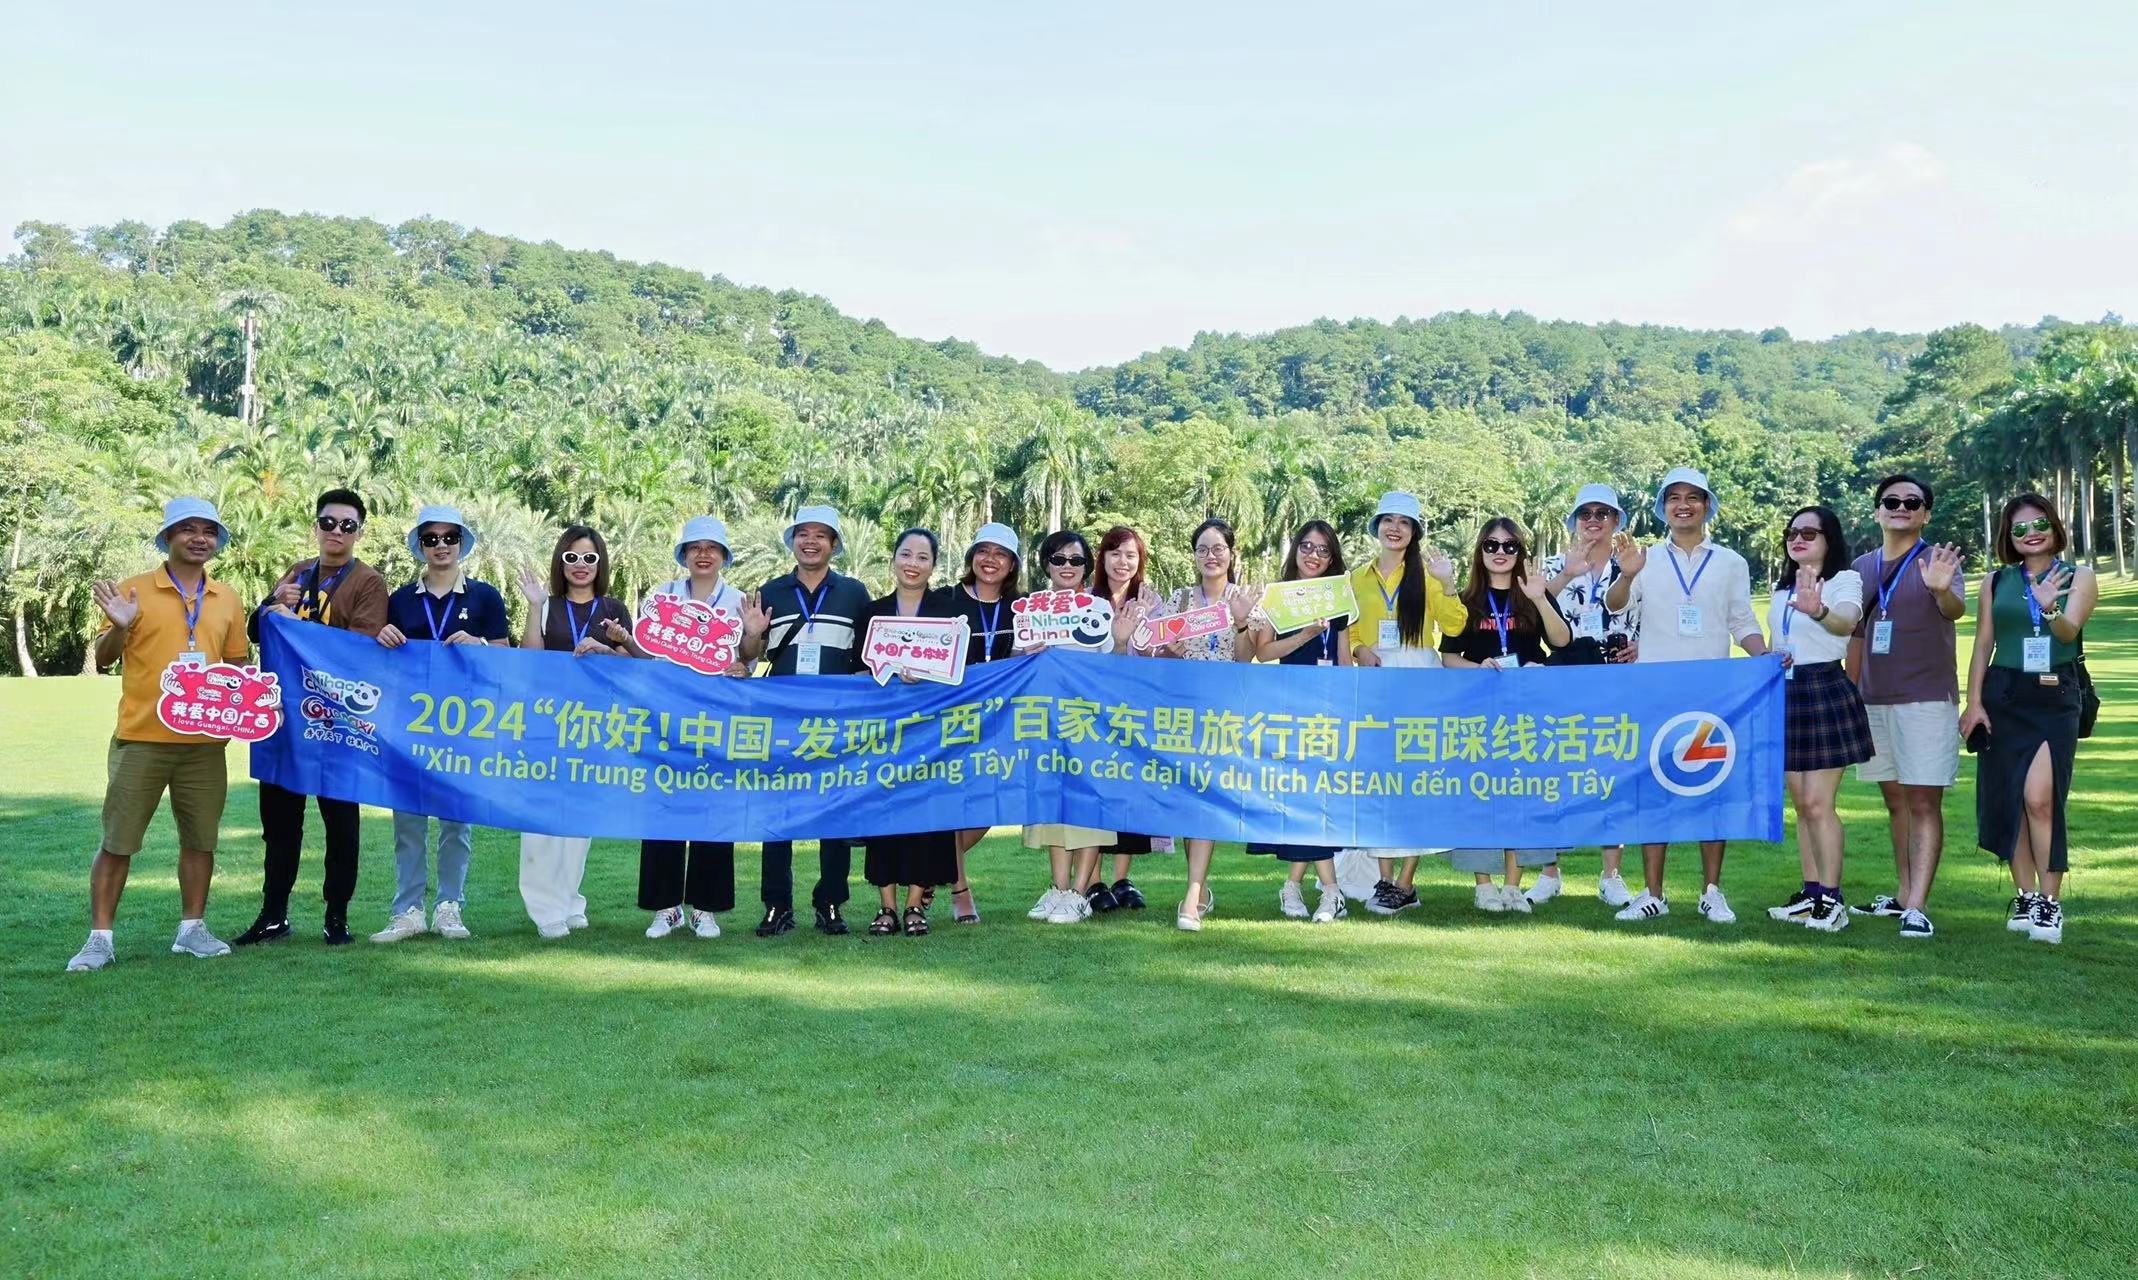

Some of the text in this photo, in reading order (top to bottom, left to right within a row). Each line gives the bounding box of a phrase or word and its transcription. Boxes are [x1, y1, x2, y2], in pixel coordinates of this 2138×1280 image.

[1028, 590, 1073, 614] 我爱
[1031, 614, 1080, 627] Nihao
[647, 621, 728, 661] 我爱中国广西
[1017, 627, 1070, 641] China
[874, 642, 950, 661] 中国广西你好
[310, 672, 355, 692] Nihao
[171, 701, 270, 729] 我爱中国广西
[177, 718, 195, 727] love
[232, 724, 256, 735] CHINA
[411, 743, 1616, 803] "Xin chào! Trung Quốc-Khám phá Quảng Tây" cho các đại lý du lịch ASEAN đến Quảng Tây
